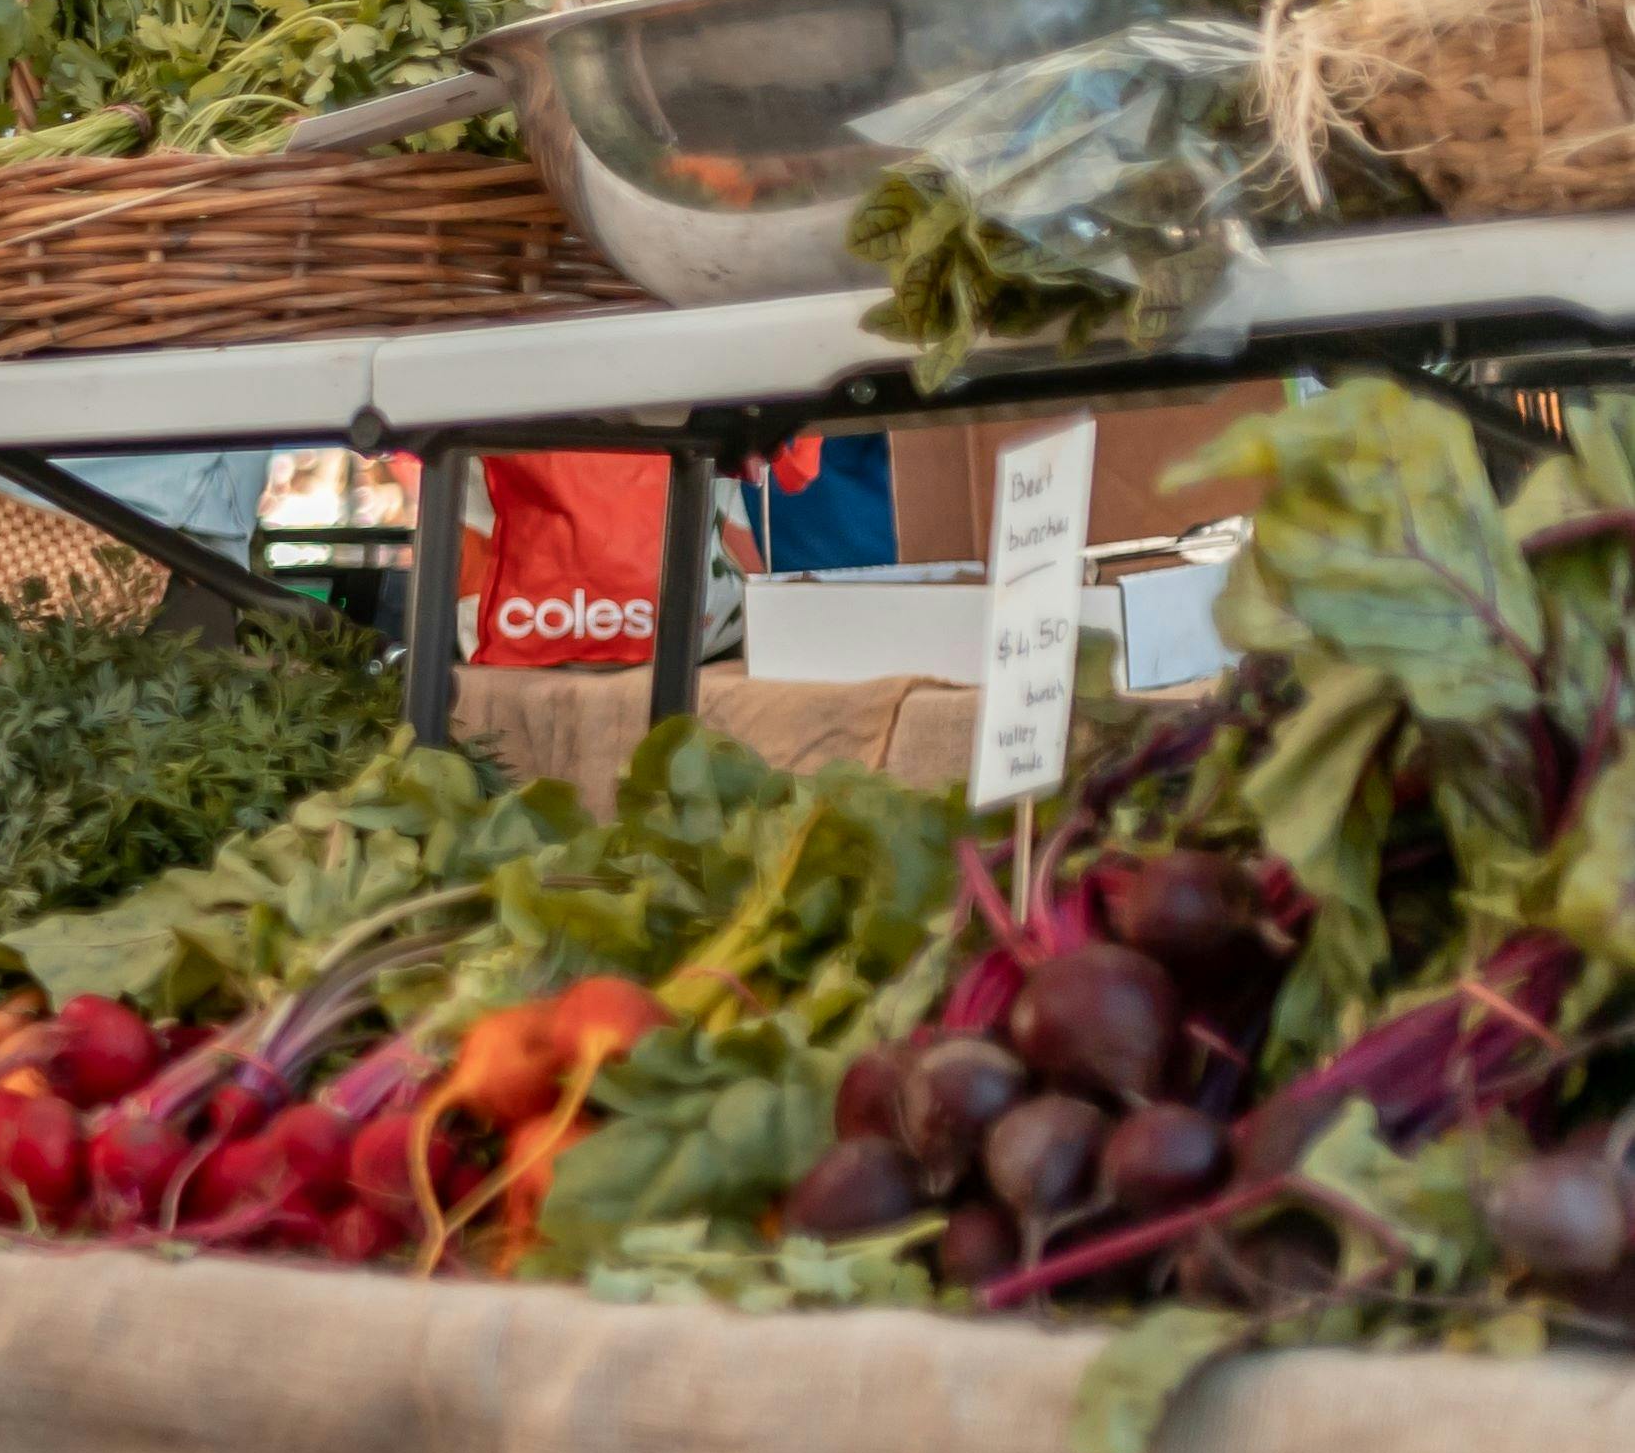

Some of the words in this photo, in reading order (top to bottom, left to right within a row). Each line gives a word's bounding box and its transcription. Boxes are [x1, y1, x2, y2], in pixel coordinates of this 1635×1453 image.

[1011, 462, 1054, 503] Beet
[497, 587, 654, 640] coles
[997, 616, 1069, 669] $4.50
